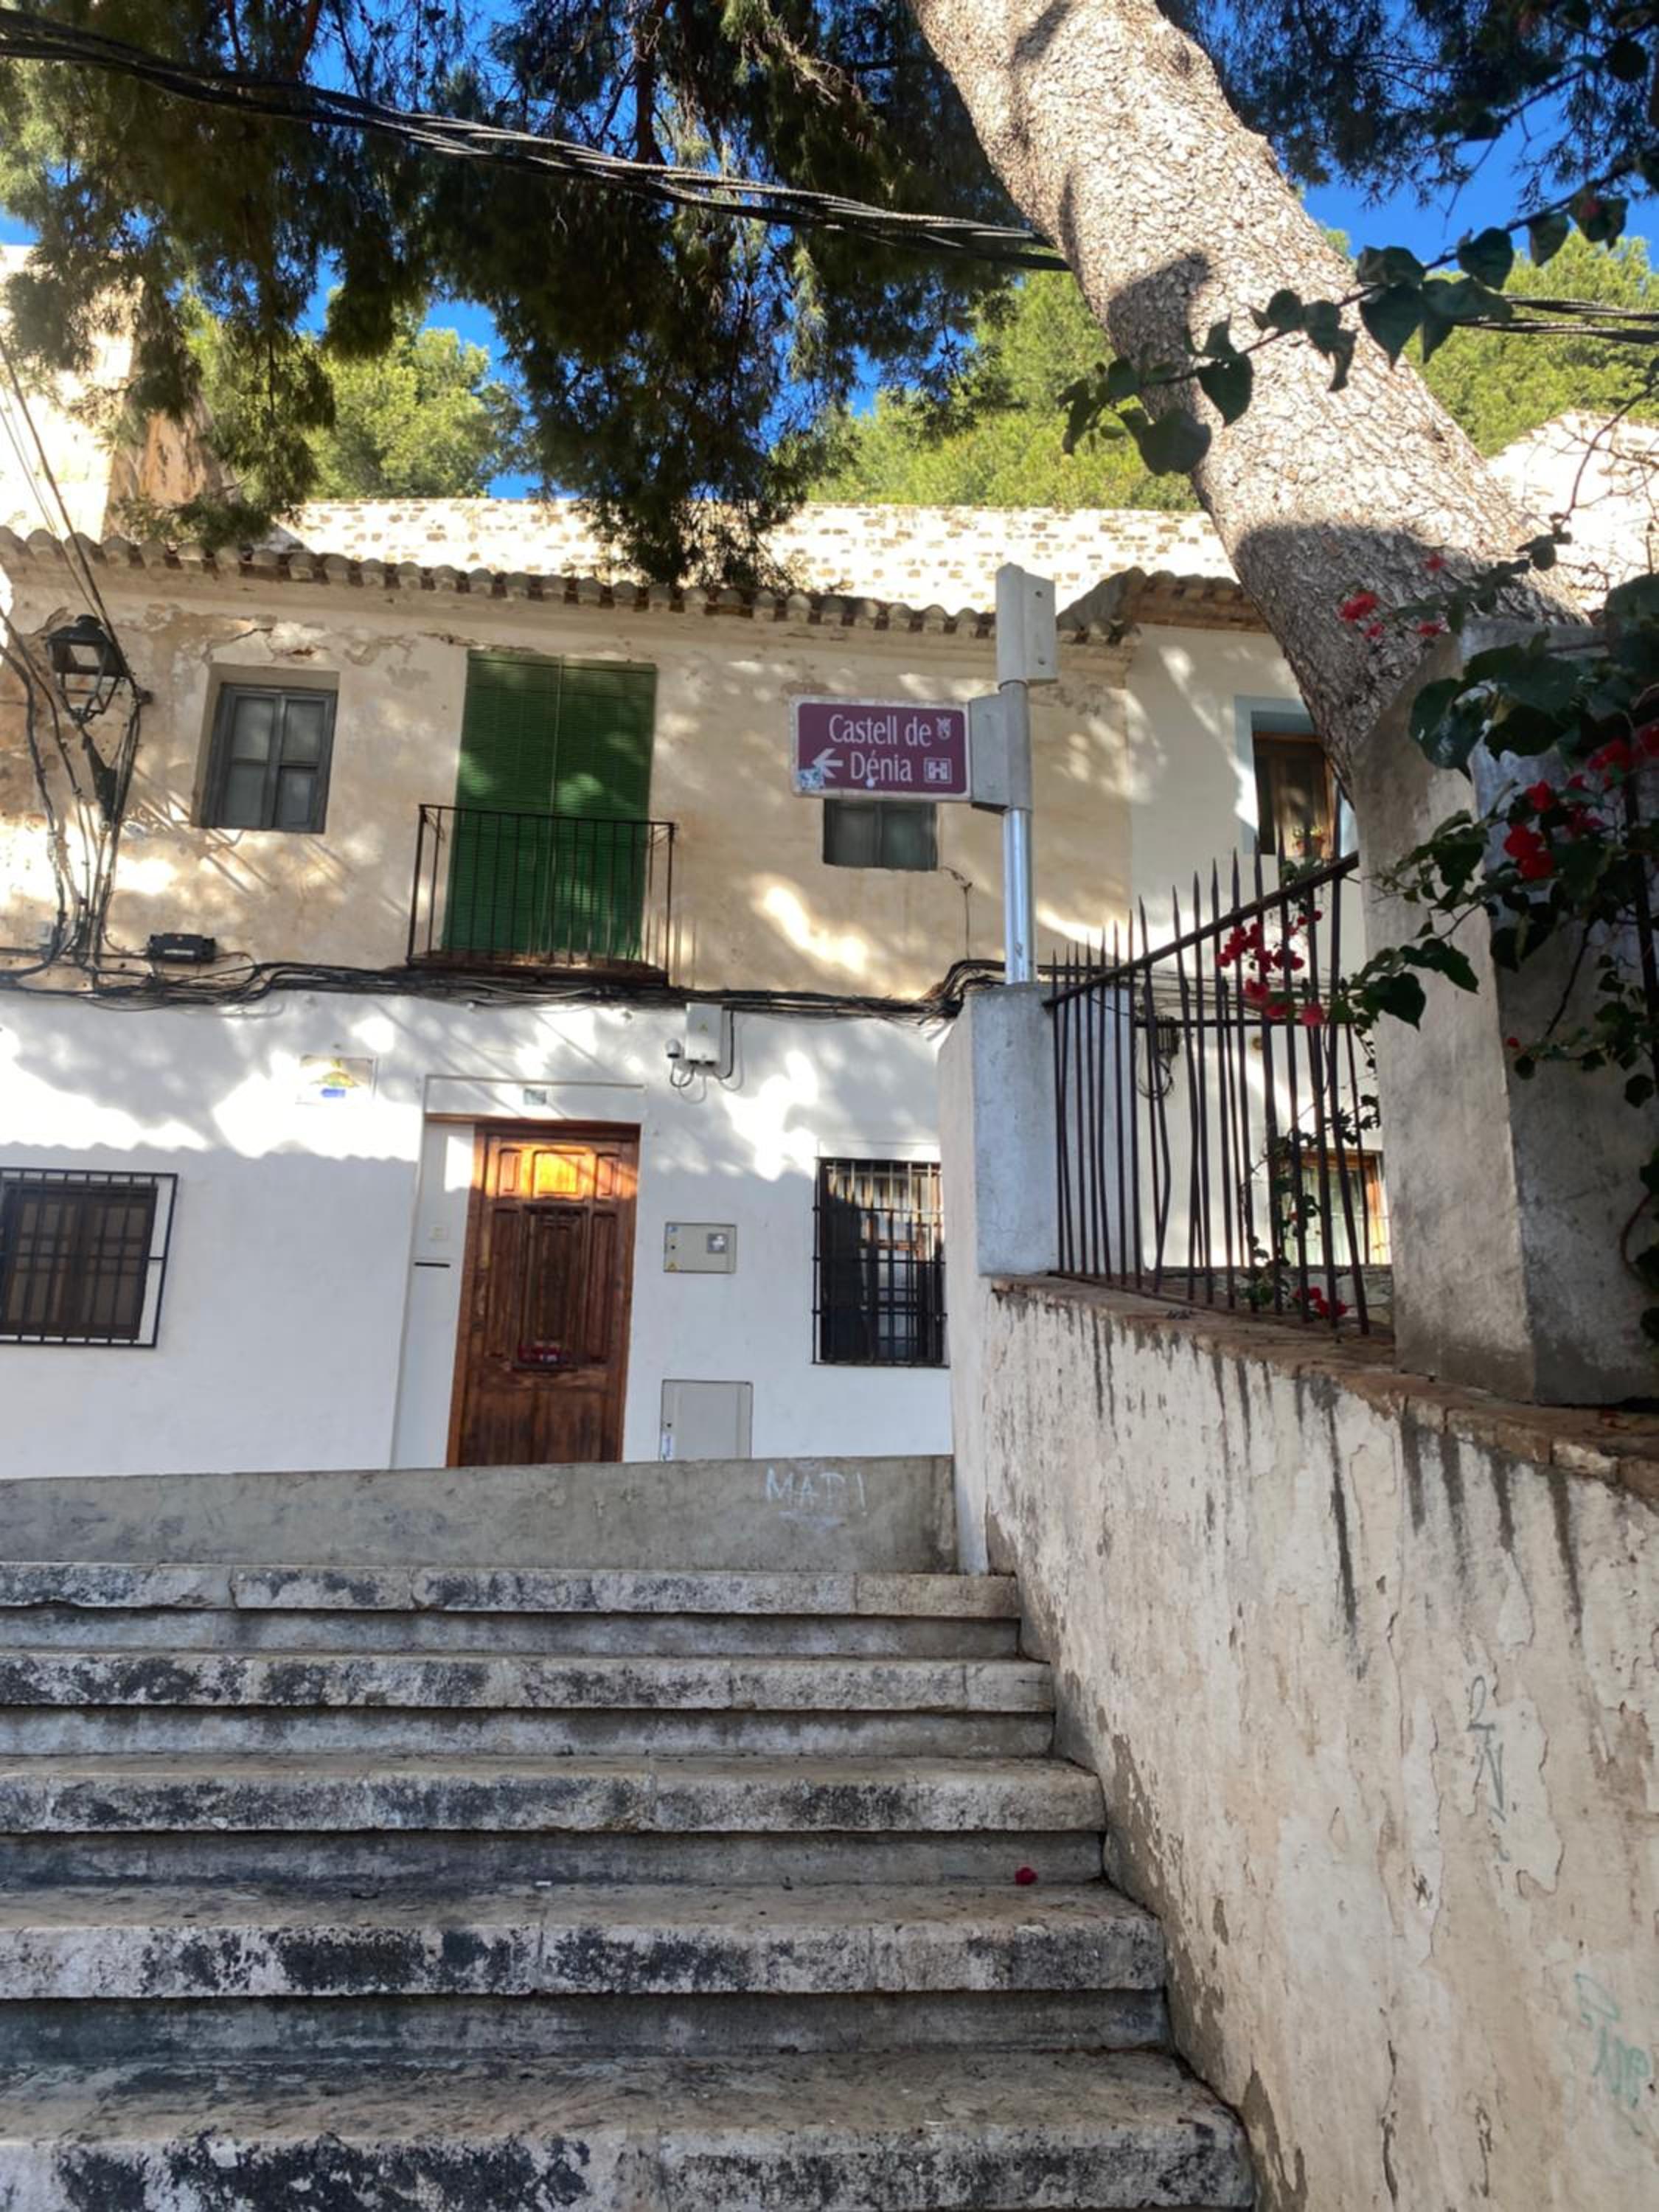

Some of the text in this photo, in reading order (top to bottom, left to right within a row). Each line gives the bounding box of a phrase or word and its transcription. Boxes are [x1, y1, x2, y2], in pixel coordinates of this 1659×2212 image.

[829, 714, 932, 747] Castell de
[849, 750, 913, 782] Dénia
